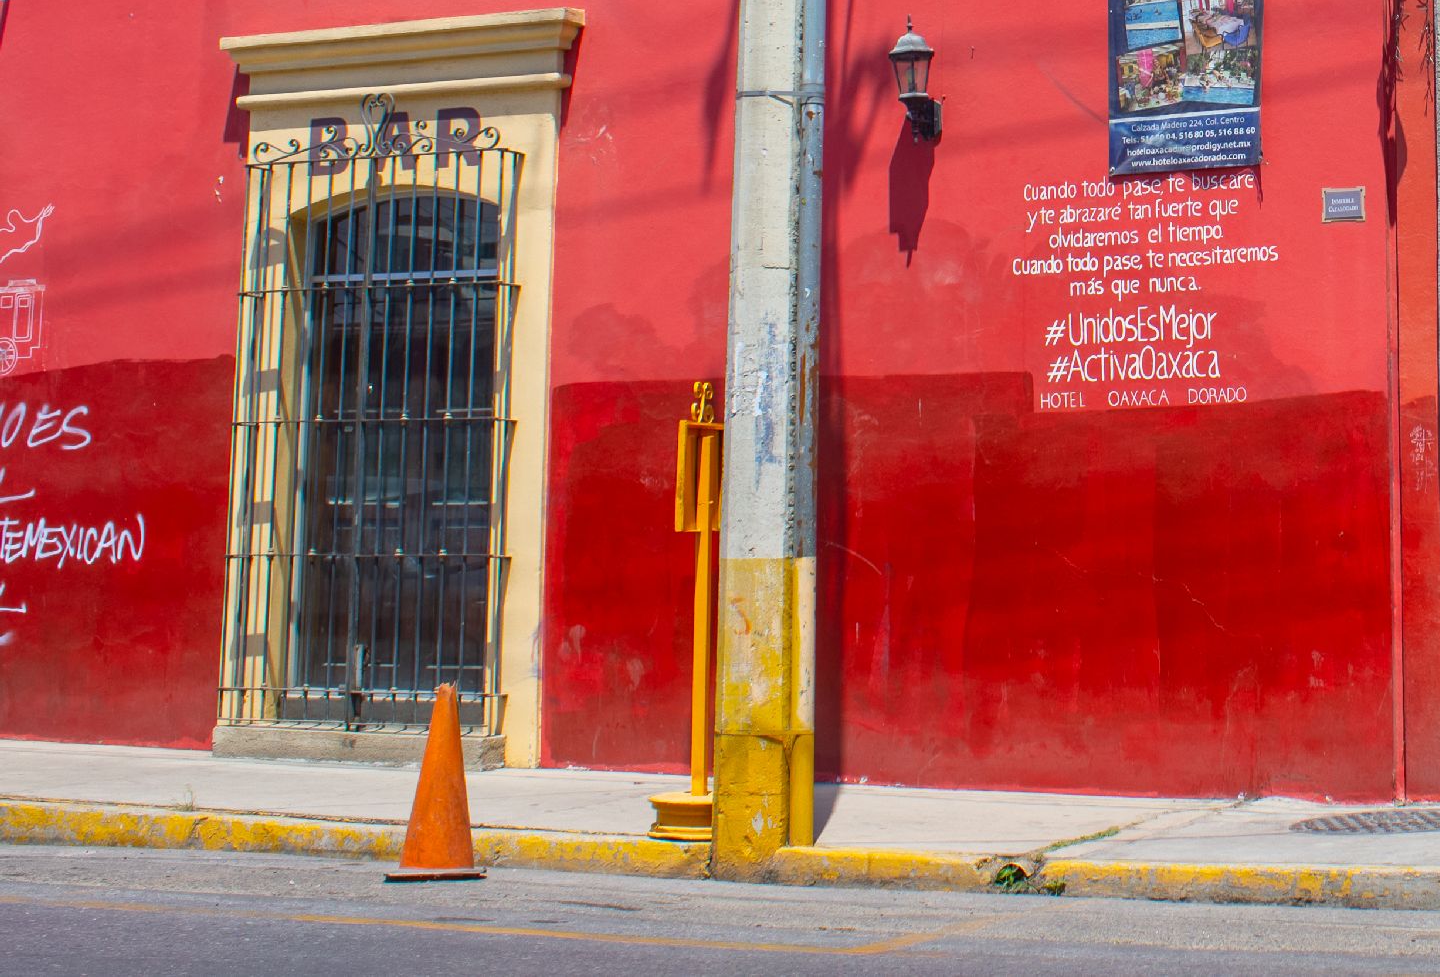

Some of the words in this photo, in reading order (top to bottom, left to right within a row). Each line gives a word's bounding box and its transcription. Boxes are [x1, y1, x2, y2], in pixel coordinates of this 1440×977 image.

[1131, 122, 1160, 132] Calzada
[1160, 121, 1187, 130] Madero
[1188, 119, 1203, 128] 224,
[1205, 118, 1219, 126] Col.
[1220, 116, 1245, 125] Centro
[1178, 131, 1193, 140] 516
[1194, 130, 1204, 139] 80
[1205, 129, 1217, 138] 05,
[1218, 128, 1232, 136] 516
[1245, 126, 1256, 134] 60
[307, 106, 482, 177] BAR
[1023, 181, 1077, 201] Cuando
[1082, 176, 1115, 197] todo
[1123, 178, 1163, 200] pase,
[1167, 174, 1185, 193] te
[1026, 211, 1038, 233] y
[1040, 206, 1055, 224] te
[1059, 203, 1121, 223] abrazaré
[1128, 201, 1151, 220] tan
[1209, 199, 1238, 221] que
[1049, 227, 1139, 249] olvidaremos
[1147, 222, 1161, 243] el
[1012, 254, 1064, 275] Cuando
[1066, 251, 1098, 273] todo
[1103, 254, 1143, 278] pase,
[1146, 249, 1164, 268] te
[1168, 245, 1279, 267] necesitaremos
[1069, 275, 1104, 297] más
[1111, 278, 1140, 302] que
[1149, 276, 1202, 293] nunca.
[1045, 304, 1217, 348] #UnidosEsMejor
[1047, 344, 1221, 383] #ActivaOaxaca
[1040, 390, 1086, 410] HOTEL
[1107, 389, 1169, 407] OAXACA
[1188, 386, 1247, 405] DORADO
